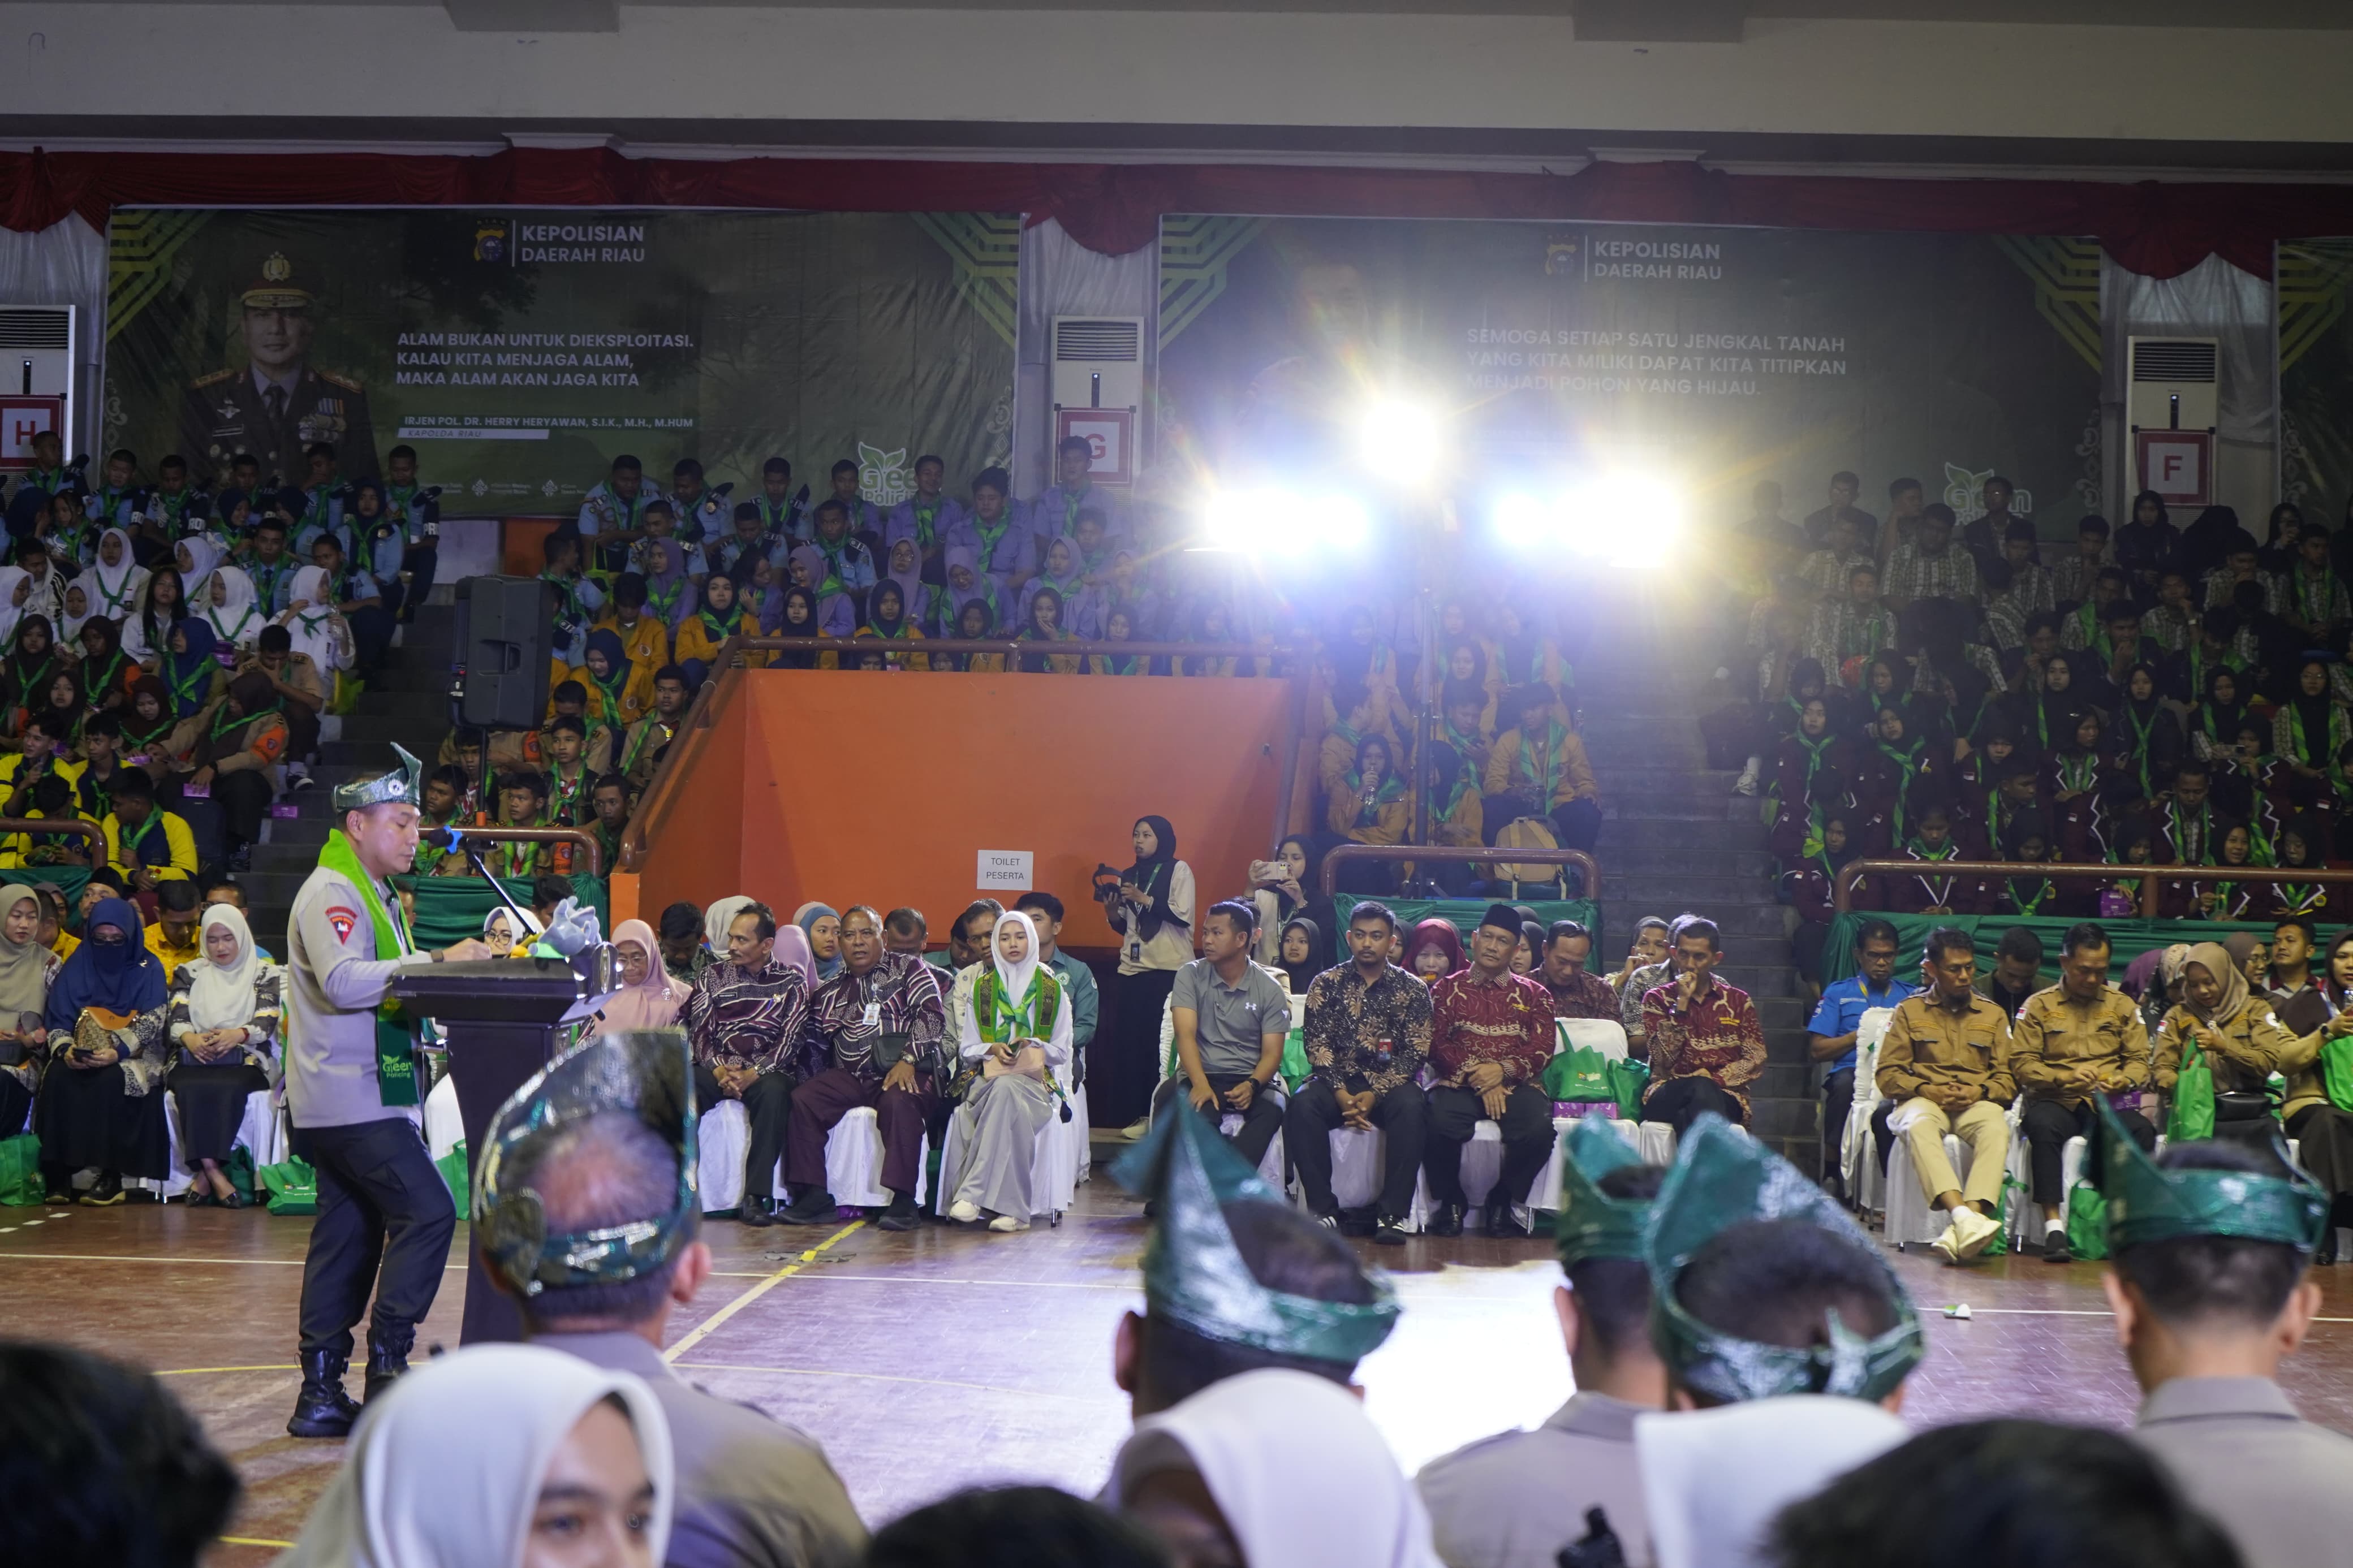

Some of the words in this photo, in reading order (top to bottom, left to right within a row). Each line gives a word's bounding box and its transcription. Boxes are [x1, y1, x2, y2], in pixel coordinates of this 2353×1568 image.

[522, 225, 644, 242] KEPOLISIAN
[522, 247, 596, 262] DAERAH
[601, 248, 645, 262] RIAU
[1594, 240, 1720, 260] KEPOLISIAN
[1594, 263, 1671, 279] DAERAH
[1678, 264, 1722, 280] RIAU
[398, 333, 443, 347] ALAM
[448, 334, 505, 347] BUKAN
[510, 334, 565, 347] UNTUK
[569, 334, 694, 348] DIEKSPLOITASI.
[1467, 328, 1552, 345] SEMOGA
[1557, 330, 1623, 347] SETIAP
[1628, 331, 1679, 348] SATU
[1684, 332, 1772, 351] JENGKAL
[1777, 335, 1846, 352] TANAH
[397, 352, 451, 366] KALAU
[455, 353, 493, 366] KITA
[497, 353, 578, 366] MENJAGA
[582, 354, 634, 368] ALAM,
[1467, 349, 1523, 368] YANG
[1528, 351, 1572, 369] KITA
[1578, 353, 1634, 371] MILIKI
[1639, 354, 1704, 372] DAPAT
[1710, 356, 1753, 373] KITA
[1759, 357, 1846, 375] TITIPKAN
[396, 372, 446, 385] MAKA
[450, 372, 497, 386] ALAM
[501, 373, 548, 386] AKAN
[552, 373, 597, 386] JAGA
[602, 373, 639, 387] KITA
[1467, 373, 1555, 391] MENJADI
[1560, 375, 1630, 392] POHON
[1635, 377, 1691, 394] YANG
[1697, 378, 1761, 396] HIJAU.
[404, 416, 436, 426] IRJEN
[438, 417, 462, 426] POL.
[464, 417, 482, 426] DR.
[485, 417, 520, 427] HERRY
[522, 417, 589, 428] HERYAWAN,
[654, 418, 693, 427] M.HUM
[16, 420, 36, 446] H
[1084, 433, 1106, 460] G
[2164, 455, 2183, 482] F
[990, 857, 1020, 866] TOILET
[986, 871, 1024, 880] PESERTA
[382, 1061, 412, 1073] Green
